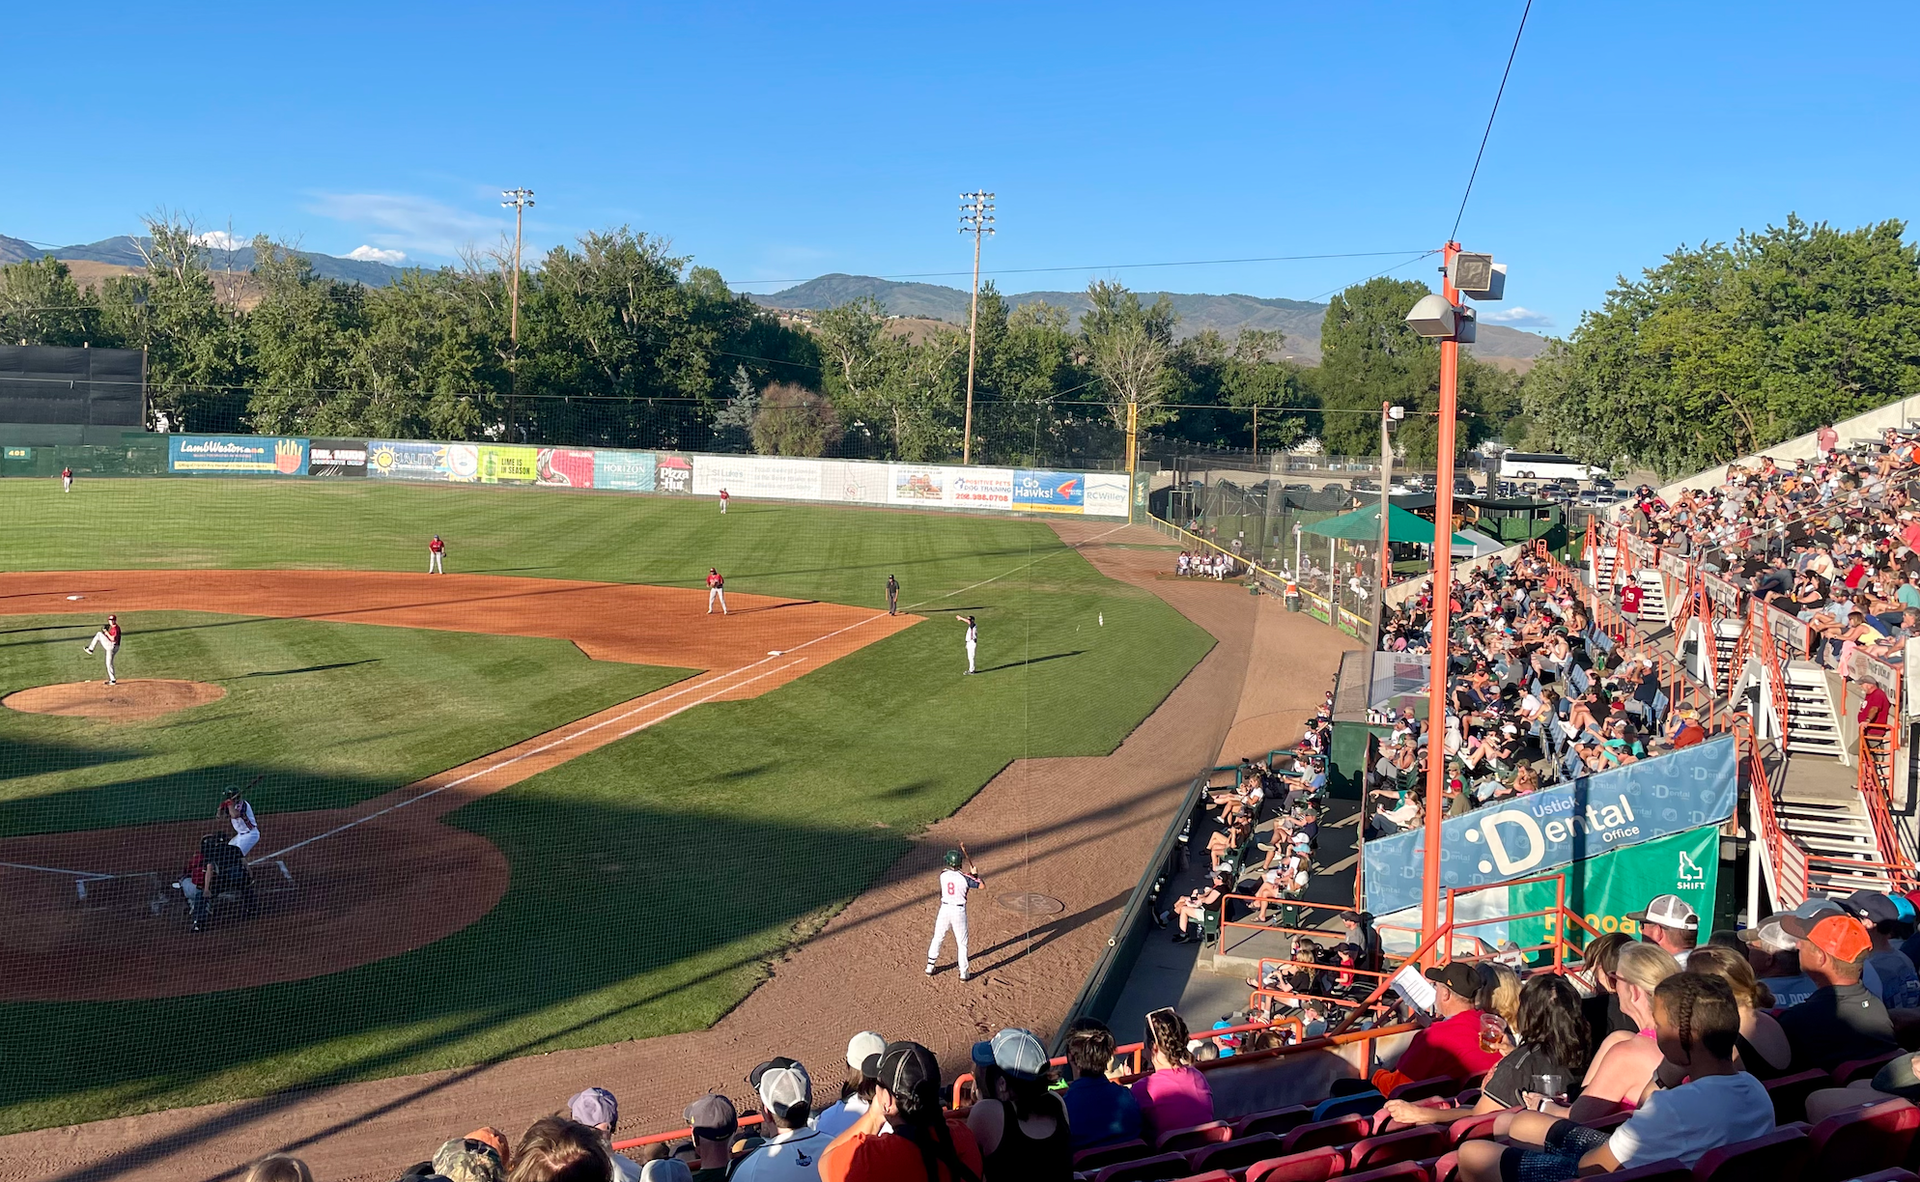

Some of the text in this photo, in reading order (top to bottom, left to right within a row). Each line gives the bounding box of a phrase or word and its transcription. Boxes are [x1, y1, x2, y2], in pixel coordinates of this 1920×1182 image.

[501, 458, 523, 467] LIME IS
[603, 463, 645, 473] HORIZON
[500, 466, 531, 475] IN SEASON
[660, 467, 689, 480] Pizza
[661, 478, 684, 491] Hut
[1022, 477, 1039, 488] Go
[980, 485, 1012, 493] TRAINING
[1014, 486, 1054, 498] Hawks!
[1532, 795, 1580, 818] Ustick
[1602, 825, 1640, 843] Office
[947, 882, 956, 896] 8
[1677, 882, 1706, 890] SHIFT
